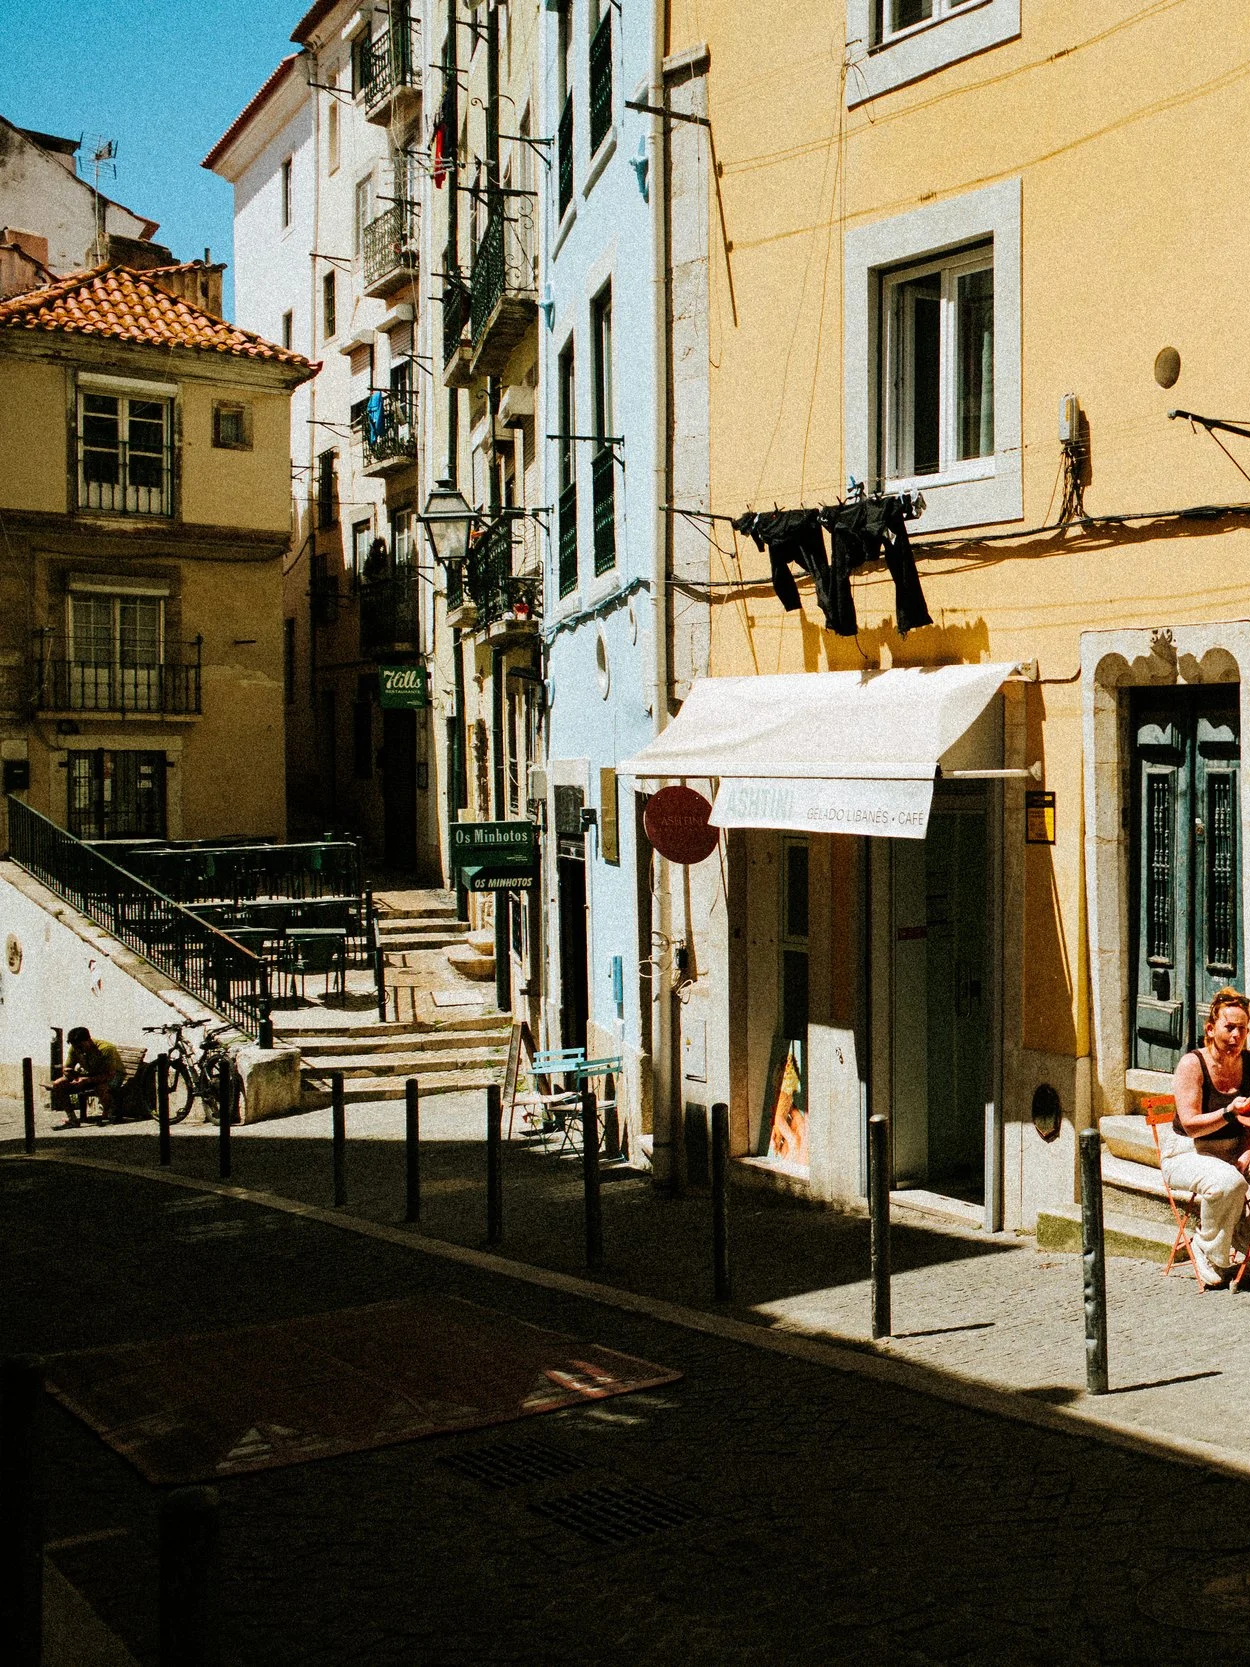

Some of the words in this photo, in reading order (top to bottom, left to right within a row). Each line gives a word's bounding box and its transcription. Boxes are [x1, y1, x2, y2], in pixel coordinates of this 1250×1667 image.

[806, 808, 844, 822] GELADO
[846, 808, 889, 824] LIBANÊS
[897, 808, 924, 826] CAFÉ
[456, 829, 471, 844] Os
[474, 828, 528, 843] Minhotos
[475, 878, 486, 889] OS
[488, 877, 533, 888] MINHOTOS
